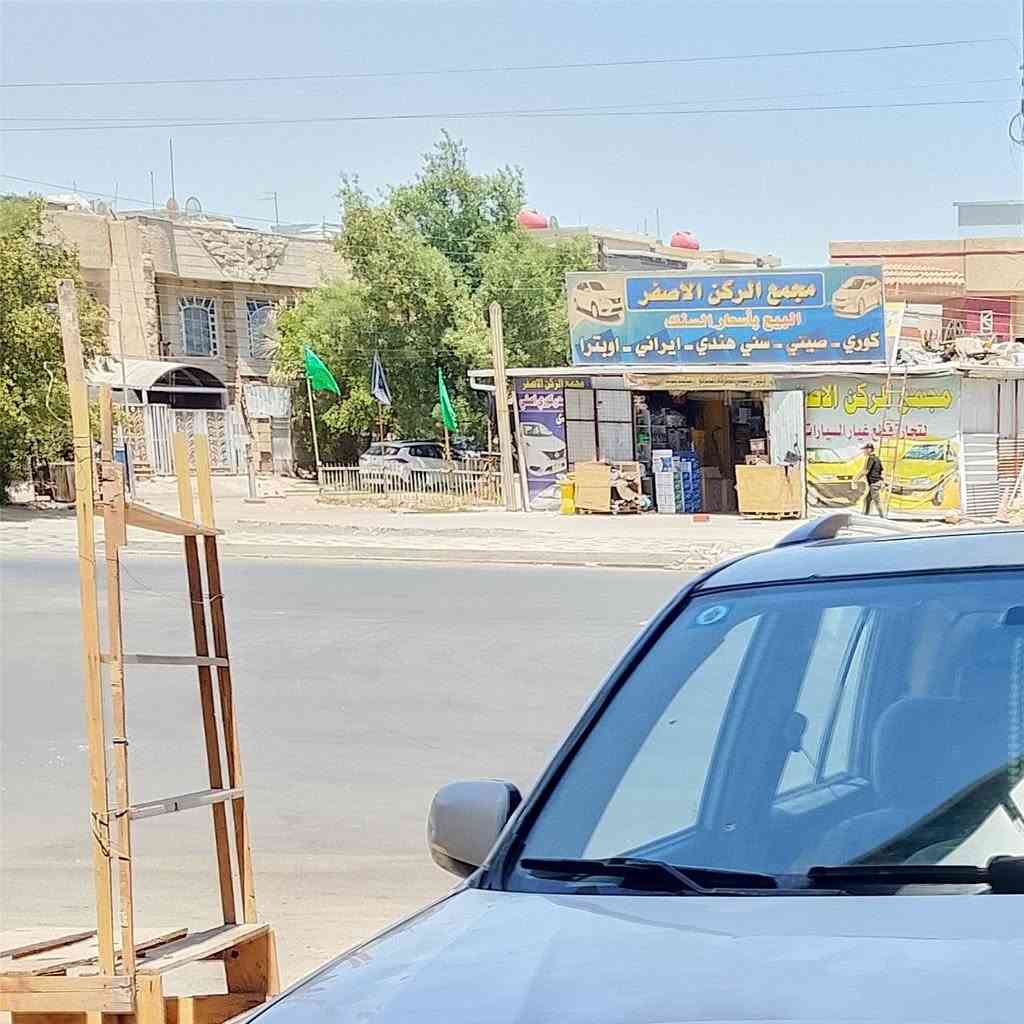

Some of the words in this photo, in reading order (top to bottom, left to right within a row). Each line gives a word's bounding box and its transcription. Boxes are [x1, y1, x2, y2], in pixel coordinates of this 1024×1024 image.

[638, 280, 704, 306] الاصفر
[708, 279, 762, 306] الركن
[767, 282, 817, 306] مجمع
[762, 311, 802, 331] البيع
[635, 334, 681, 357] ايراني
[696, 334, 736, 356] هندي
[786, 335, 828, 356] صيني
[843, 331, 880, 353] كوري
[805, 384, 838, 409] الاص
